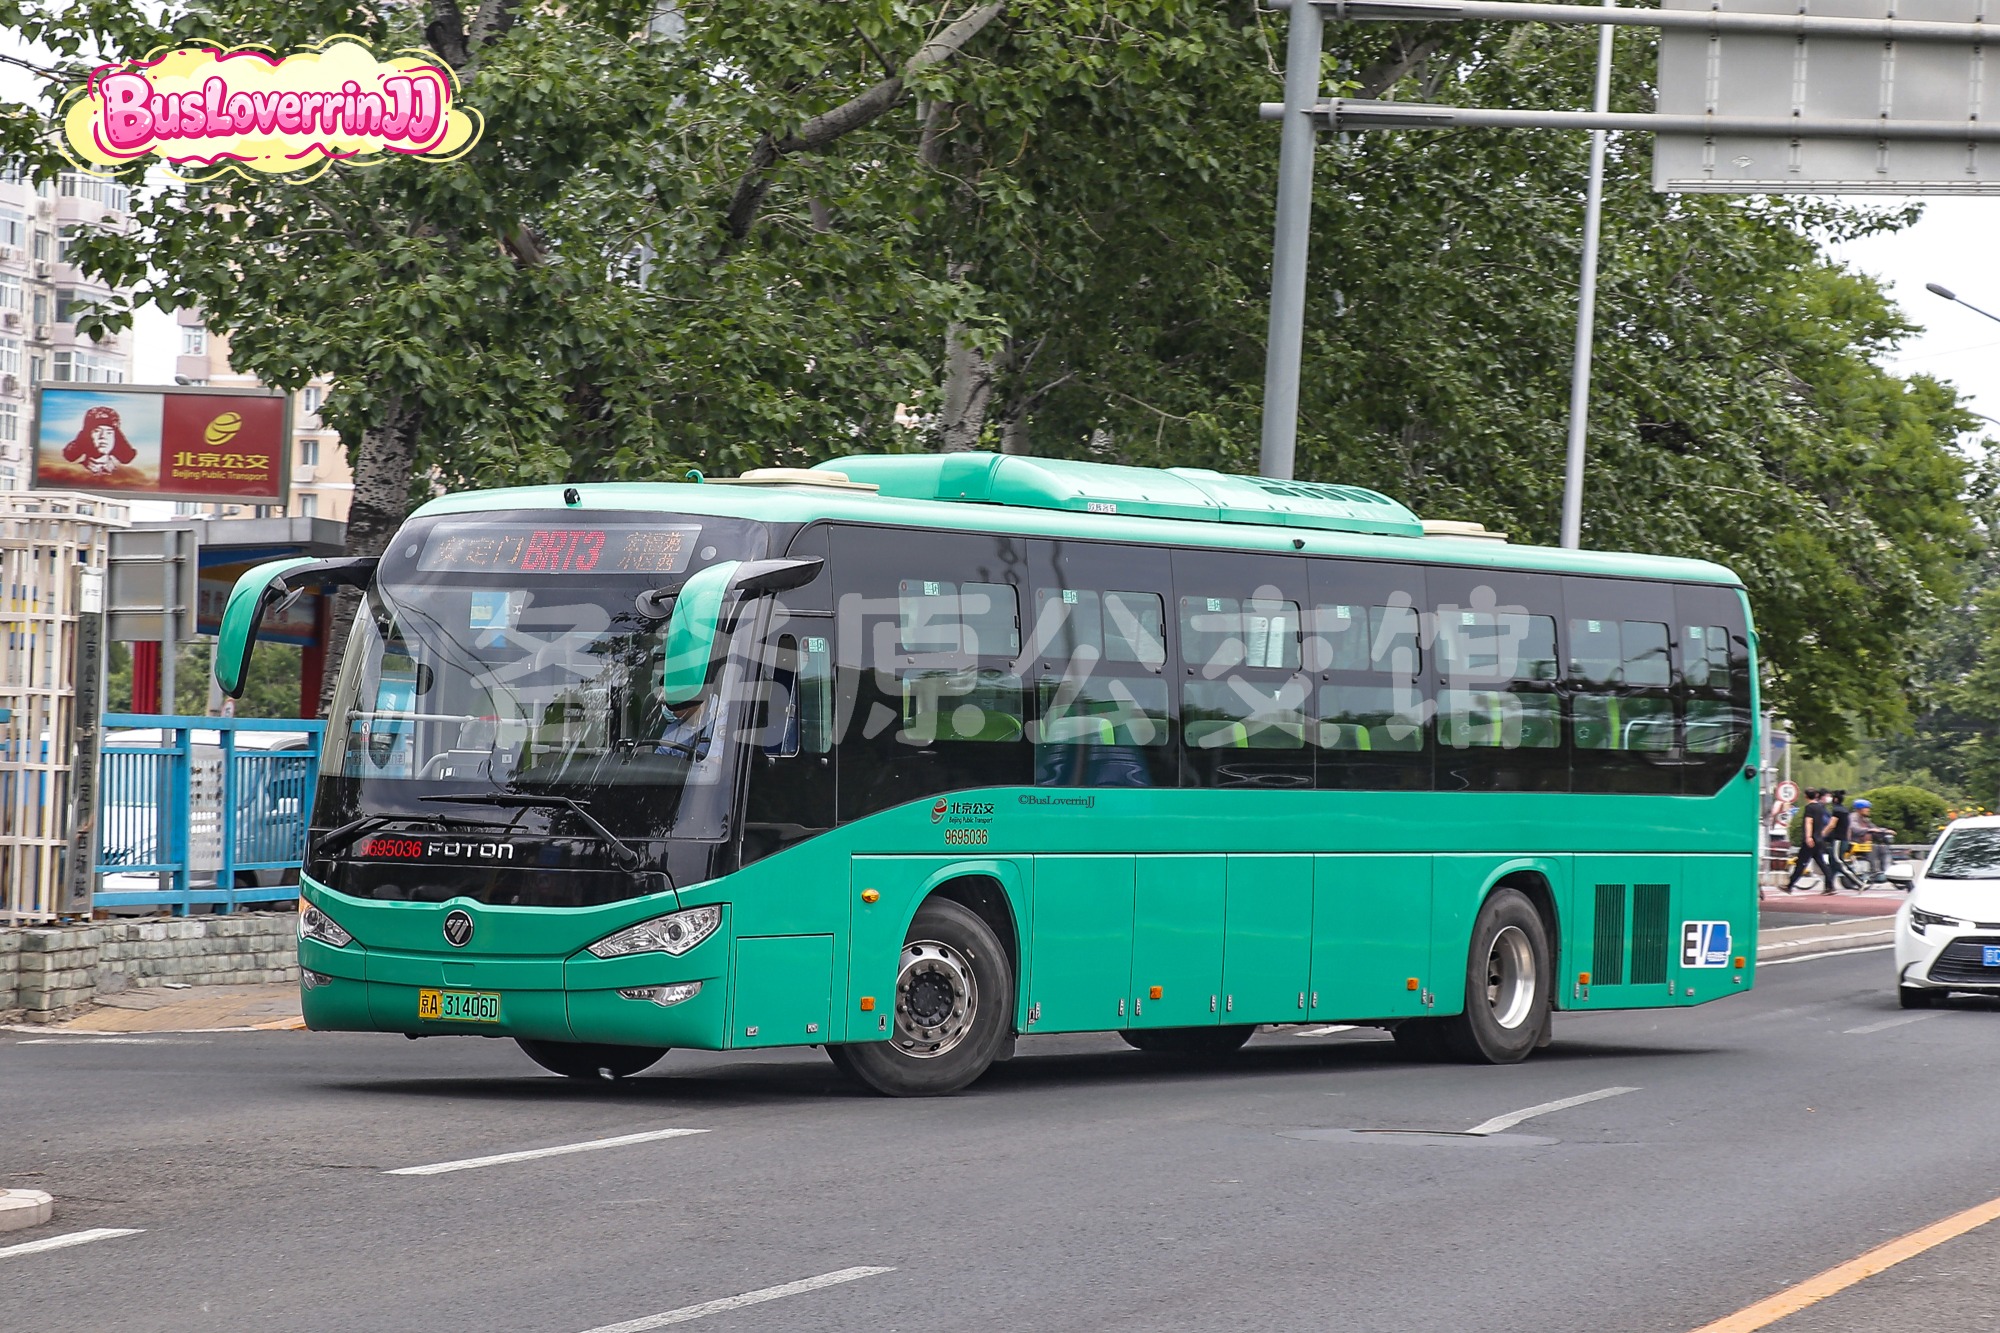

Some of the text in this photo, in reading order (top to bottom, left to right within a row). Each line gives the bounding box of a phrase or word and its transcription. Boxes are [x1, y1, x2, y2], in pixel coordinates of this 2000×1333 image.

[173, 451, 270, 470] 北京公交
[172, 469, 269, 481] Beijing Public Transport
[433, 535, 524, 565] 安定门
[520, 530, 606, 570] BRT3
[950, 802, 995, 815] 北京公交
[944, 829, 988, 845] 9695036
[361, 839, 422, 858] 9695036
